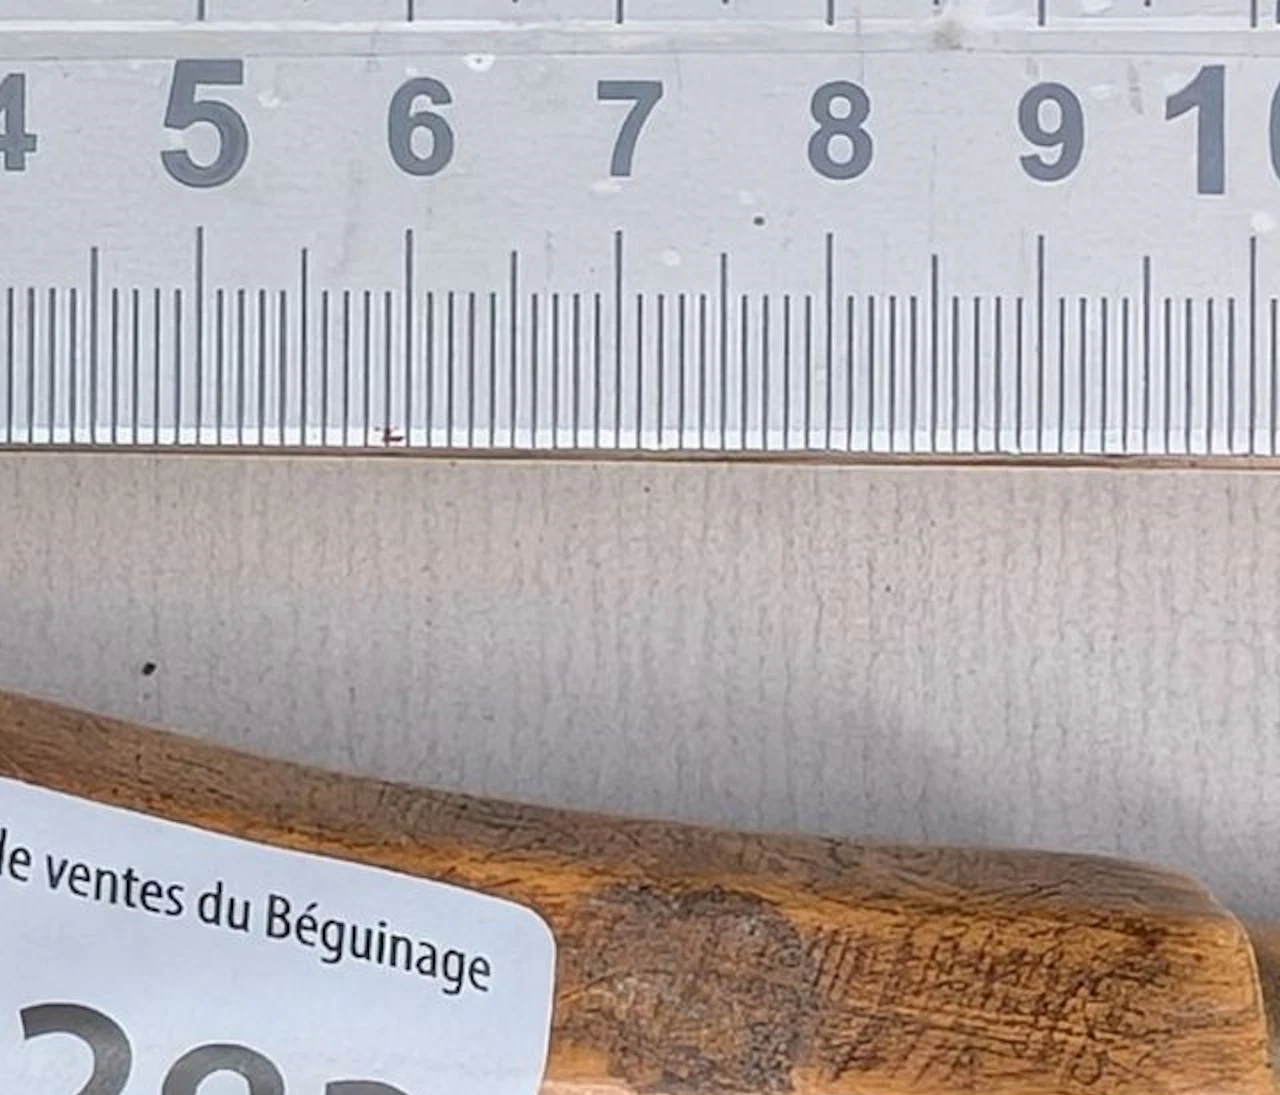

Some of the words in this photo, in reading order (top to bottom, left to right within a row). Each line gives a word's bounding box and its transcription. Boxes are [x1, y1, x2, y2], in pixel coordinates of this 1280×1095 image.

[160, 59, 249, 188] 5
[388, 77, 454, 176] 6
[597, 80, 663, 177] 7
[808, 81, 873, 180] 8
[1018, 82, 1084, 182] 9
[45, 854, 185, 917] ventes
[197, 880, 251, 933] du
[265, 893, 491, 995] Béguinage
